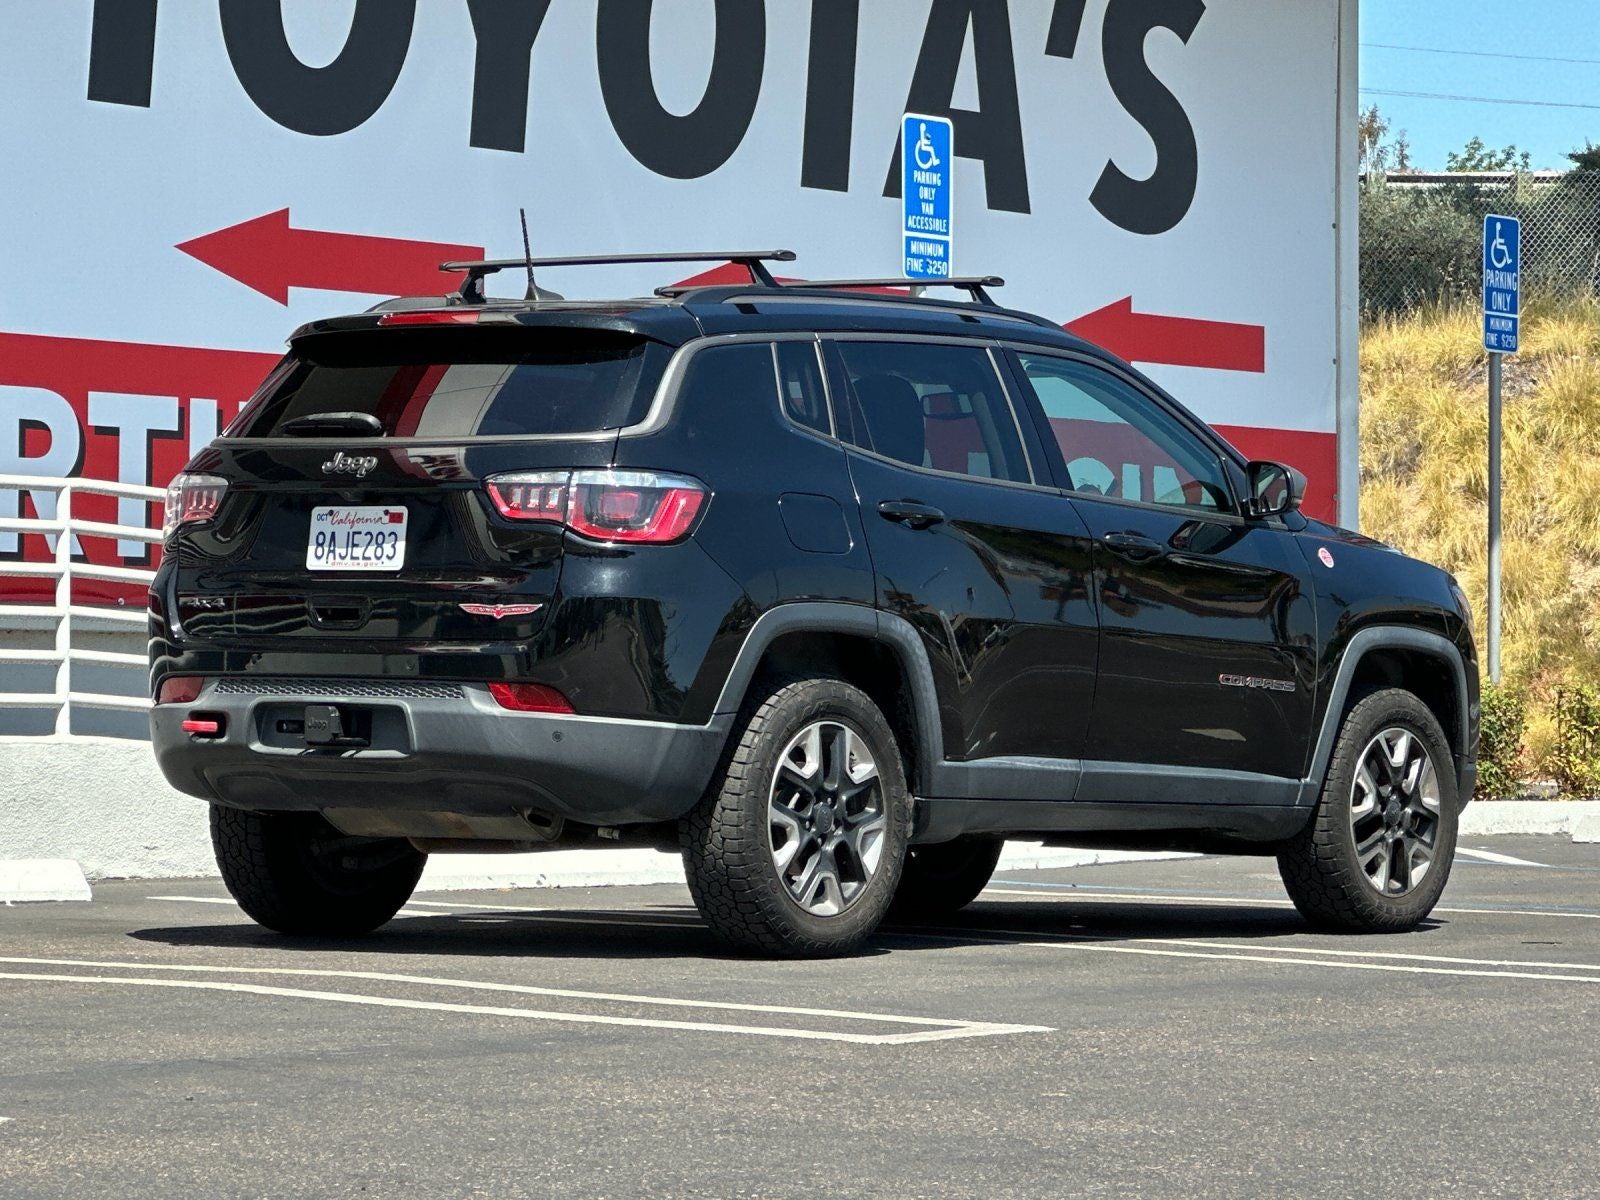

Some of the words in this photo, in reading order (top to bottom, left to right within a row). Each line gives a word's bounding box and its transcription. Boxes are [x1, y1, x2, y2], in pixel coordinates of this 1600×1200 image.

[913, 170, 941, 186] PARKING
[918, 186, 936, 200] ONLY
[921, 202, 934, 215] VAN
[907, 215, 947, 232] ACCESSIBLE
[910, 240, 944, 257] MINIMUM
[906, 257, 924, 272] FINE
[926, 257, 947, 275] $250
[1485, 269, 1517, 291] PARKING
[1491, 291, 1511, 311] ONLY
[1489, 317, 1512, 331] MINIMUM
[1486, 332, 1498, 346] FINE
[1501, 333, 1516, 348] $250
[321, 451, 379, 478] Jeep
[316, 513, 328, 522] OCT
[330, 511, 384, 529] California
[314, 531, 398, 560] 8AJE283
[1218, 673, 1296, 691] COMPASS
